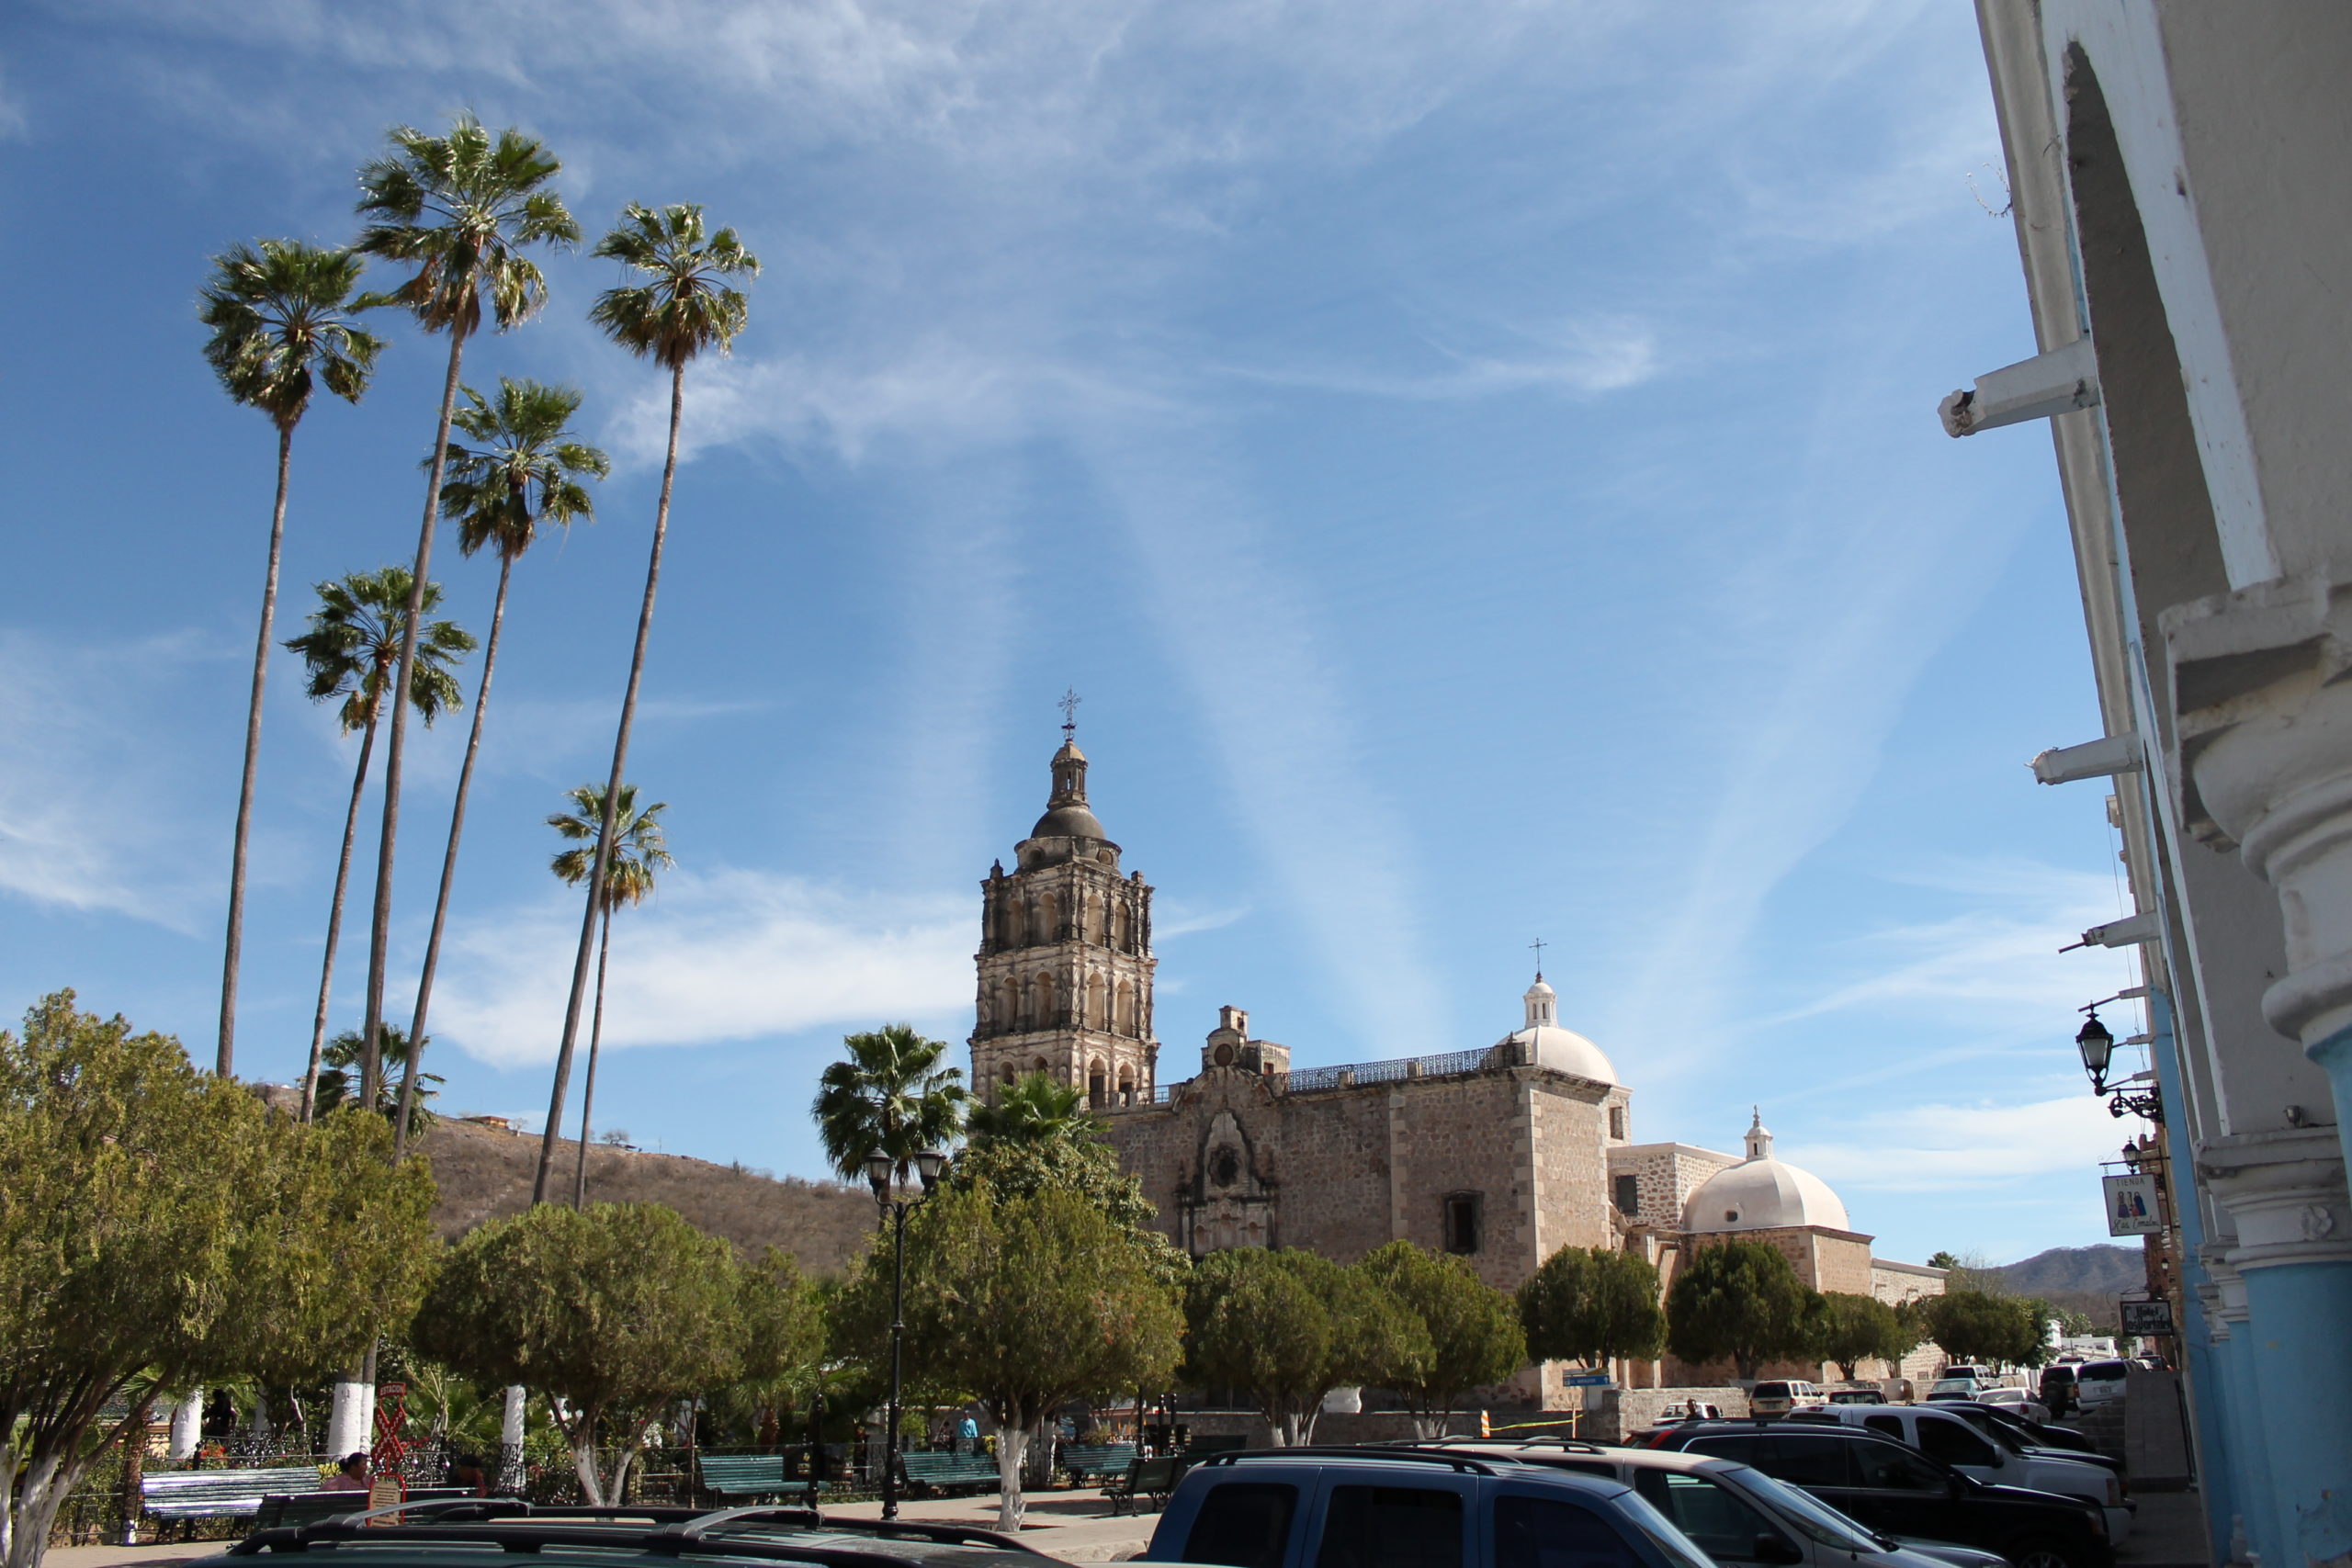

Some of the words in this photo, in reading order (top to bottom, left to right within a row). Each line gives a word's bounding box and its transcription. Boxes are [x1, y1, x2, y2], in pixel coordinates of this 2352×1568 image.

[2116, 1178, 2145, 1187] TIENDA
[2134, 1305, 2159, 1317] Hotel
[380, 1384, 404, 1395] ESTACION
